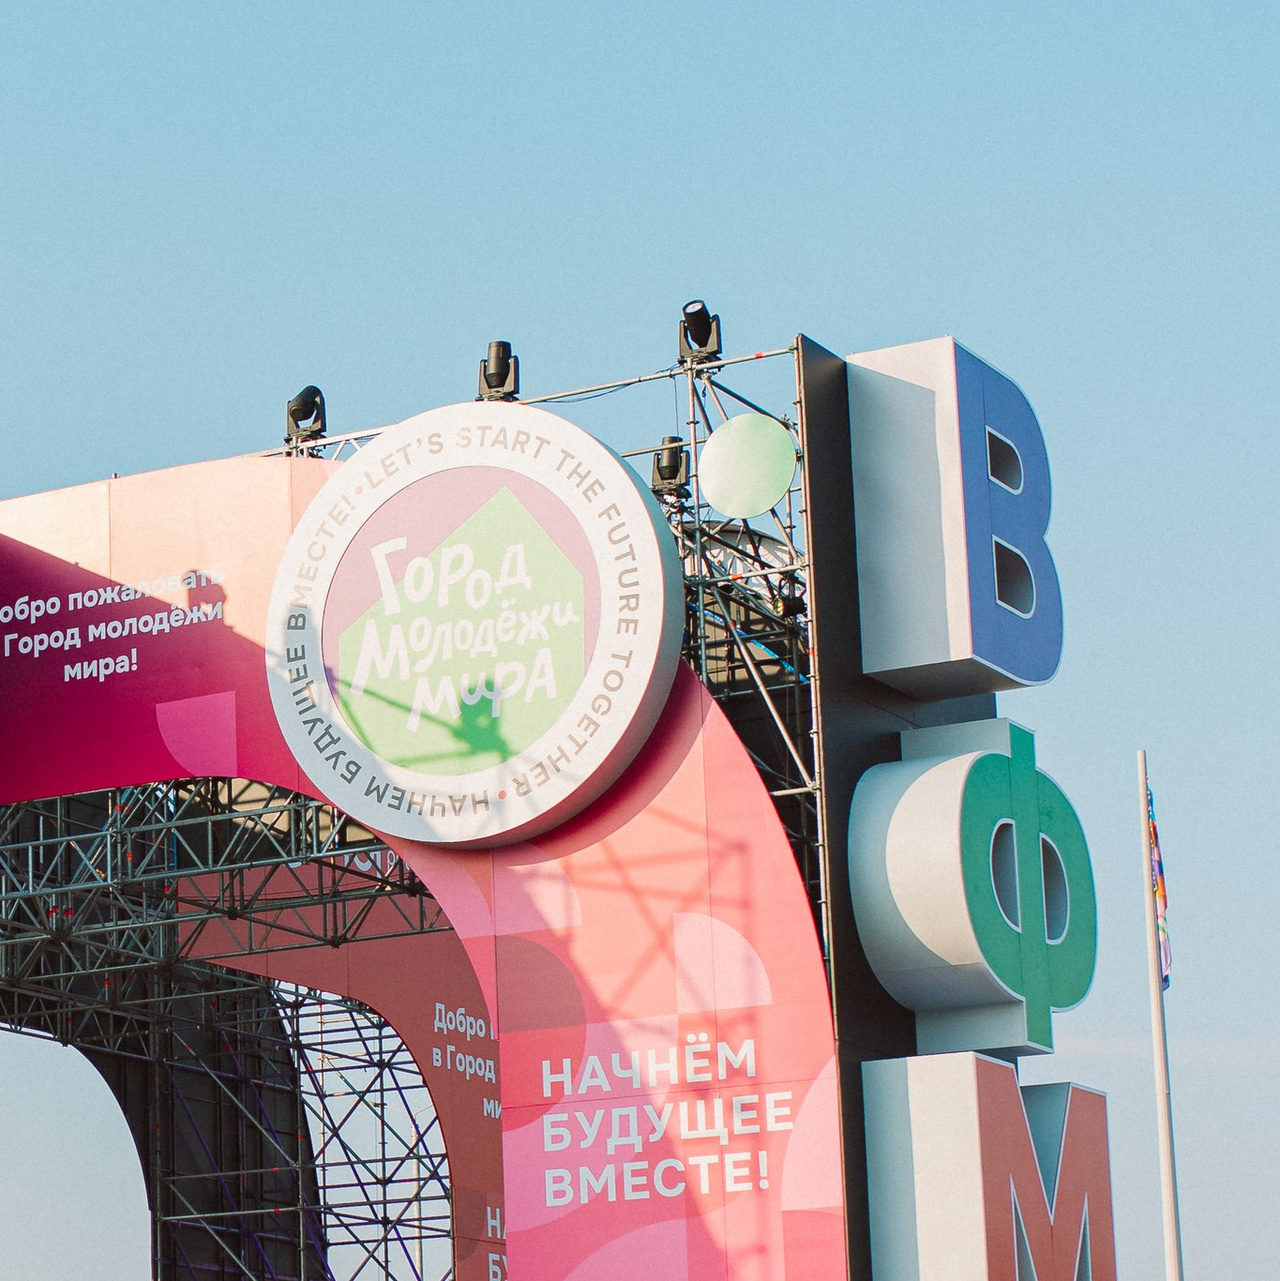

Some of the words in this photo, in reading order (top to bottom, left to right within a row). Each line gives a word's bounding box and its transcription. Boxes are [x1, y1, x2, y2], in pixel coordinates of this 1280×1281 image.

[455, 424, 551, 460] START
[554, 447, 607, 504] THE
[67, 568, 225, 612] пожаловать
[286, 493, 358, 632] ВМЕСТЕ!
[596, 502, 640, 637] FUTURE
[4, 628, 82, 658] Город
[88, 601, 224, 643] молодёжи
[63, 647, 138, 683] мира!
[286, 643, 363, 783] БУДУЩЕЕ
[513, 648, 635, 799] TOGETHER
[433, 1002, 486, 1041] Добро
[432, 1047, 442, 1067] в
[446, 1044, 496, 1084] Город
[541, 1032, 757, 1098] НАЧНЁМ
[542, 1091, 794, 1156] БУДУЩЕЕ
[544, 1150, 771, 1208] ВМЕСТЕ!
